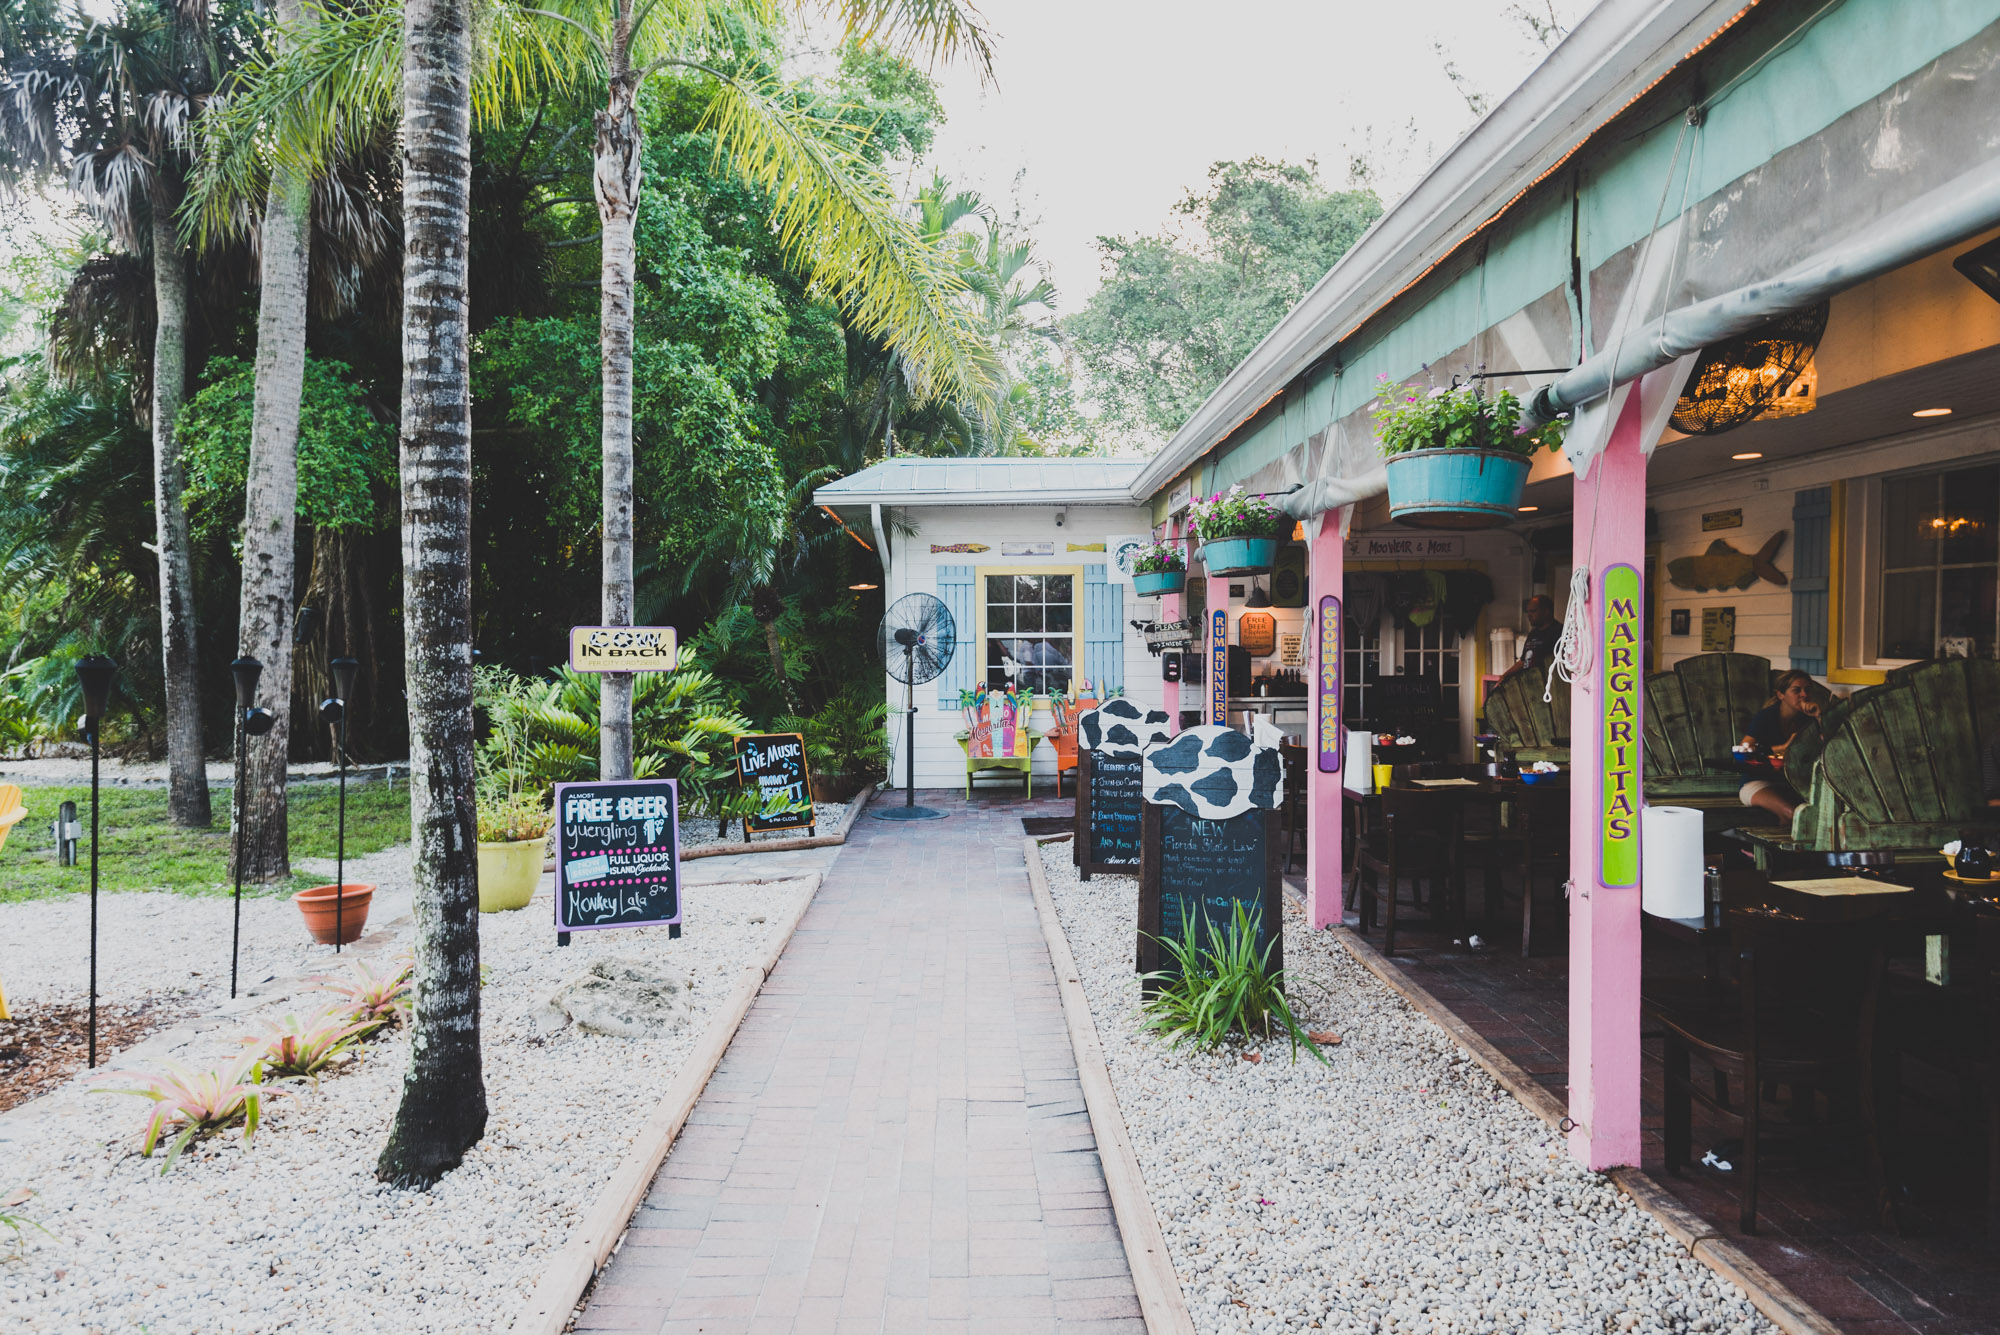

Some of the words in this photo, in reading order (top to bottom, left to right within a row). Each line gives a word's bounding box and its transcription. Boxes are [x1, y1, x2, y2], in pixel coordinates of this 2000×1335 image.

[1427, 539, 1453, 554] MORE
[589, 631, 661, 648] COW
[1154, 622, 1182, 632] PLEASE
[1215, 616, 1225, 648] RUM
[582, 644, 602, 656] IN
[608, 644, 667, 657] BACK
[1321, 605, 1338, 690] GOOMBAY
[1215, 651, 1225, 722] RUNNERS
[1321, 694, 1338, 753] SMASH
[1607, 597, 1637, 841] MARGARITAS
[741, 752, 766, 773] LIVE
[767, 743, 800, 768] MUSIC
[565, 798, 613, 823] FREE
[616, 795, 668, 820] BEER
[566, 822, 637, 850] yuengling
[1191, 820, 1227, 837] NEW
[609, 855, 630, 865] FULL
[633, 853, 669, 864] LIQUOR
[1201, 838, 1228, 852] State
[609, 866, 636, 875] ISLAND
[635, 862, 671, 876] Cocktails
[568, 890, 617, 925] Monkey
